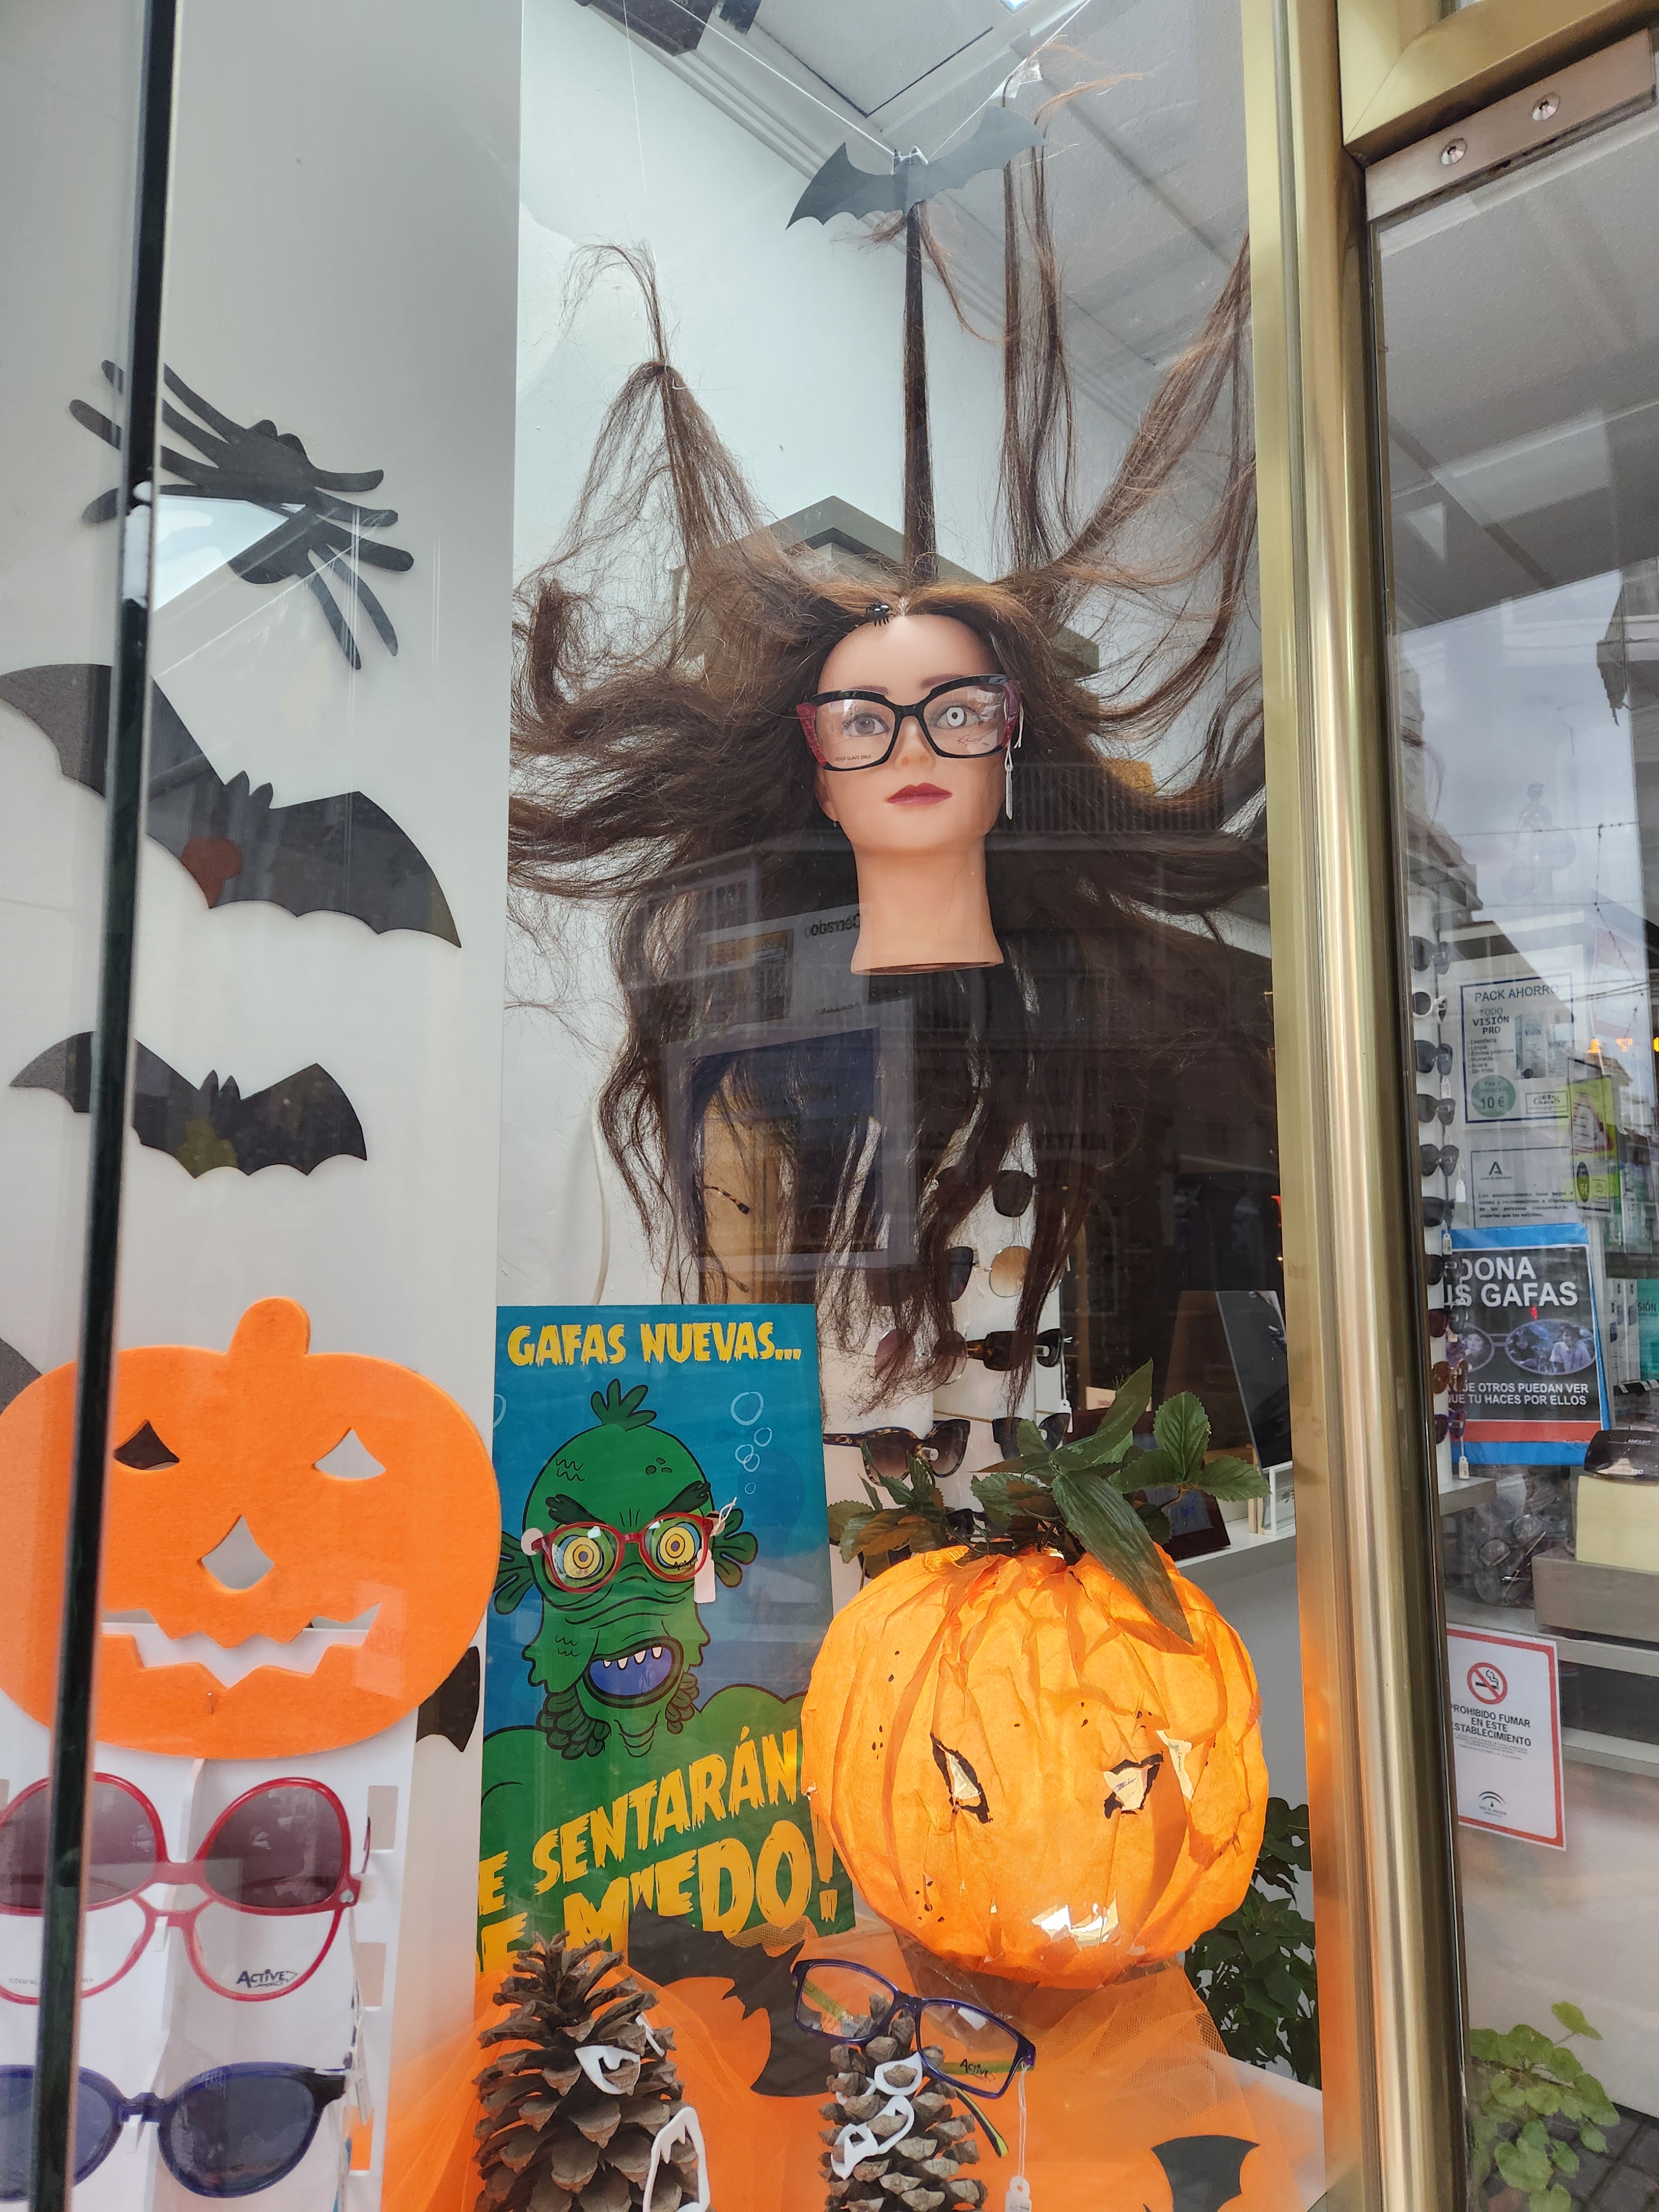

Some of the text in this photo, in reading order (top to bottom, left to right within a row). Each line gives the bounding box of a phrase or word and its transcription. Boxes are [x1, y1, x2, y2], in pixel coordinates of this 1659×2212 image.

[1475, 984, 1559, 1002] PACK AHORRO
[1479, 1007, 1503, 1016] TODO
[1473, 1015, 1510, 1026] VISIÓN
[1483, 1026, 1501, 1035] PRO
[1480, 1096, 1494, 1109] 10
[1462, 1256, 1537, 1281] DONA
[1481, 1281, 1578, 1307] GAFAS
[508, 1322, 802, 1367] GAFAS NUEVAS...
[1478, 1383, 1515, 1393] OTROS
[1519, 1383, 1563, 1393] PUEDAN
[1565, 1383, 1589, 1394] VER
[1468, 1394, 1482, 1404] TU
[1485, 1394, 1521, 1404] HACES
[1524, 1395, 1547, 1405] POR
[1550, 1395, 1587, 1405] ELLOS
[1472, 1717, 1509, 1732] EN ESTE
[1499, 1714, 1531, 1728] FUMAR
[479, 1726, 798, 1916] E SENTARÁN
